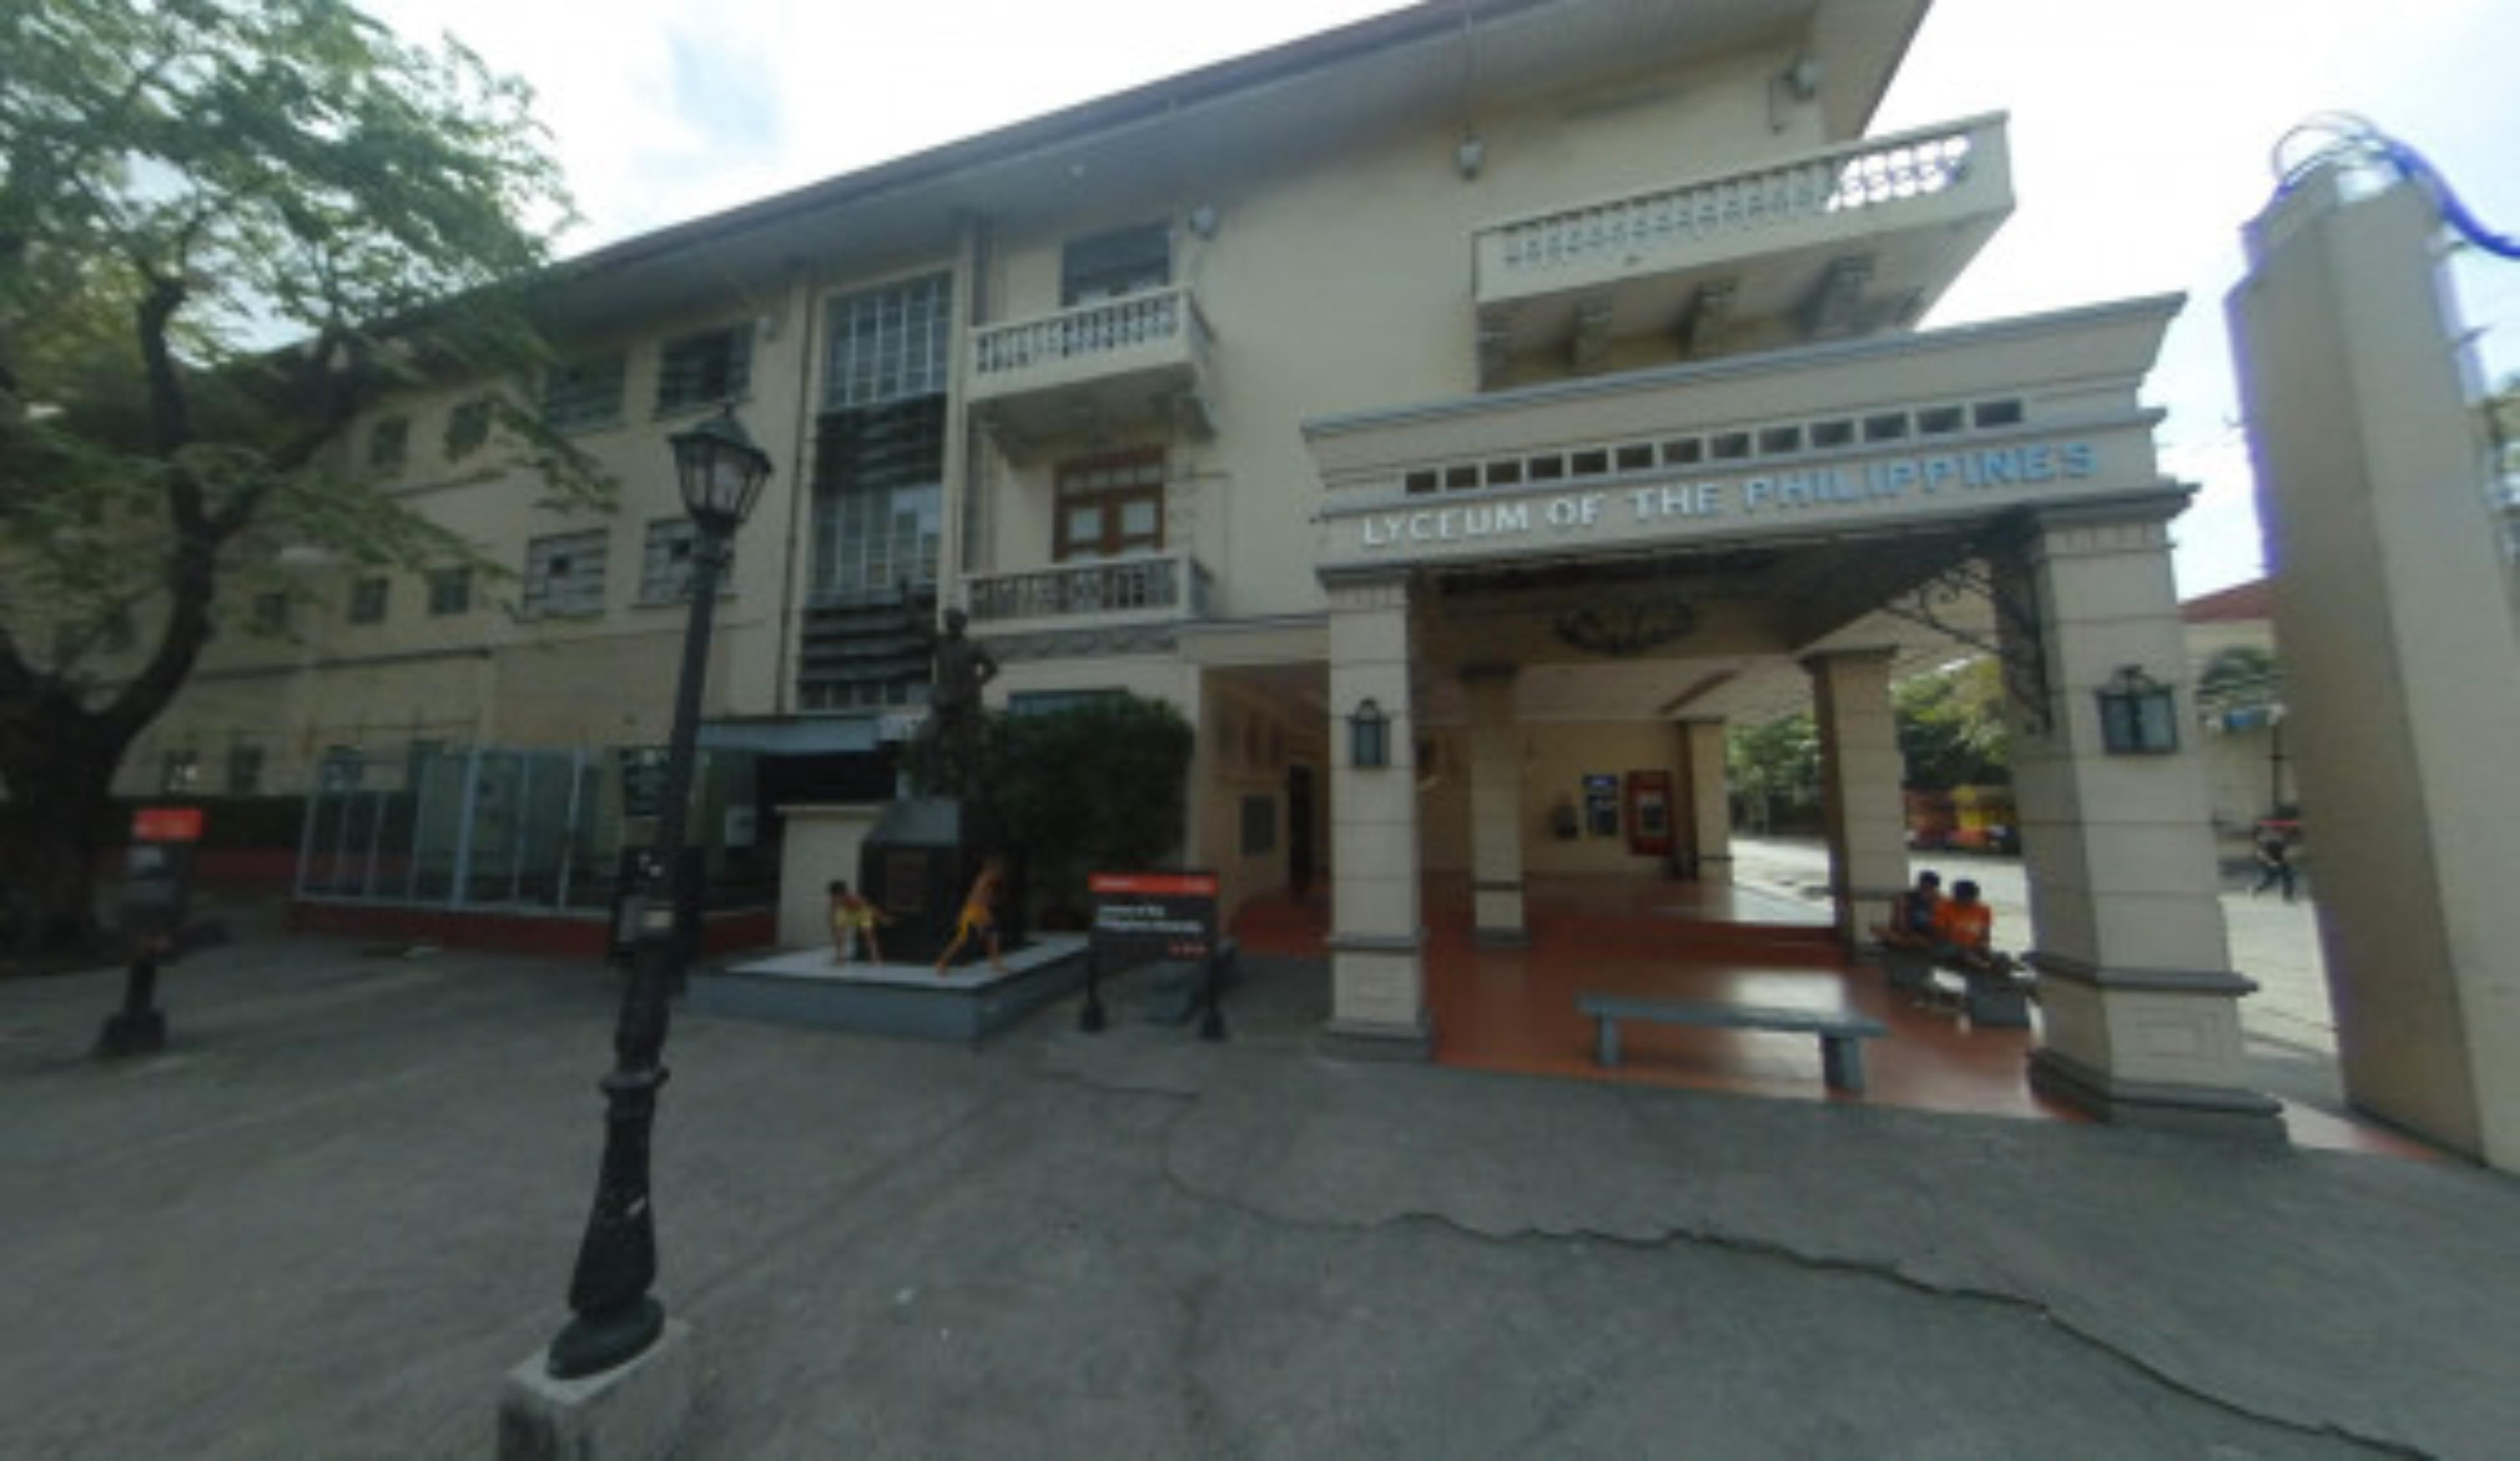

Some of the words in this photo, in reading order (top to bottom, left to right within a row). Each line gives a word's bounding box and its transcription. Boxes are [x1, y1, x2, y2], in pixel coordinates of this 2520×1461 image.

[1363, 502, 1529, 546] LYCEUM
[1547, 493, 1604, 526] OF
[1629, 482, 1721, 520] THE
[1742, 442, 2098, 509] PHILIPPINES
